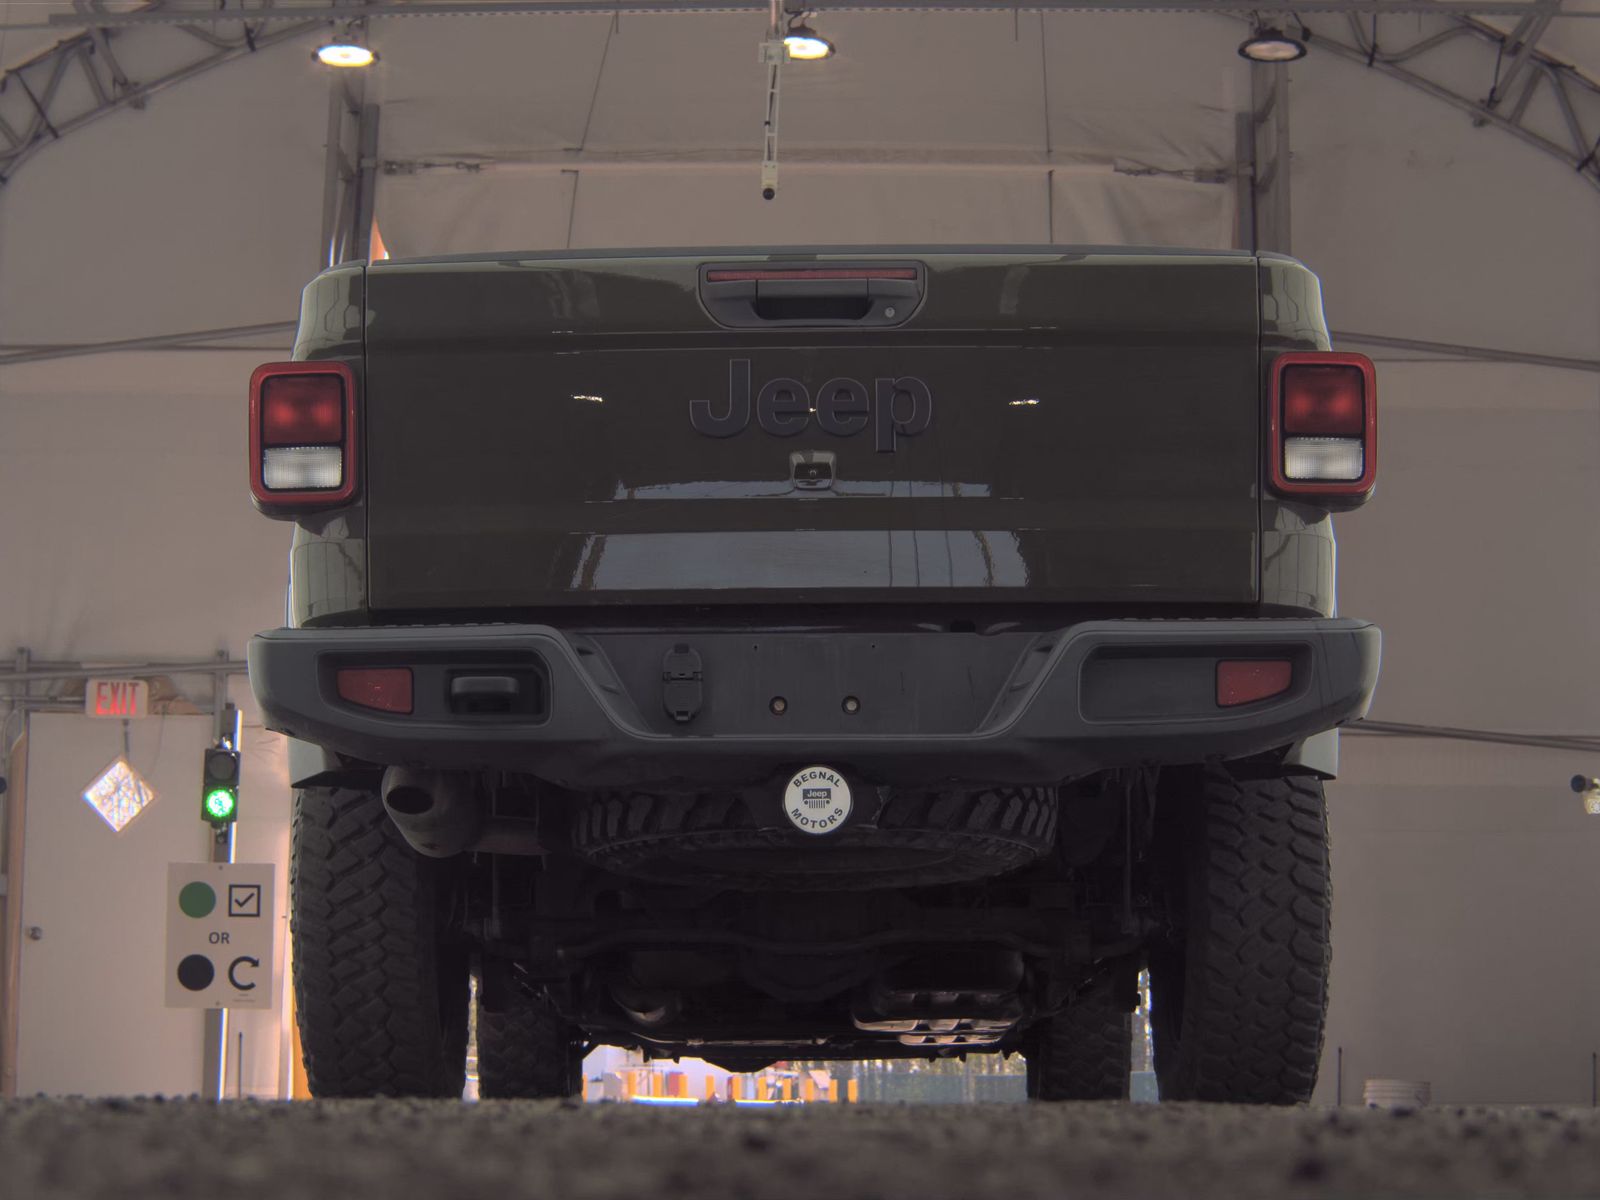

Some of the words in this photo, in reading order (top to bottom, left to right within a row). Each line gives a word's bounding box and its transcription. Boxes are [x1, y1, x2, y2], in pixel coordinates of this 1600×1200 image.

[689, 359, 932, 452] Jeep
[96, 682, 139, 717] EXIT
[793, 771, 841, 788] BEGNAL
[807, 790, 827, 799] Jeep
[791, 808, 843, 829] MOTORS
[209, 931, 230, 945] OR
